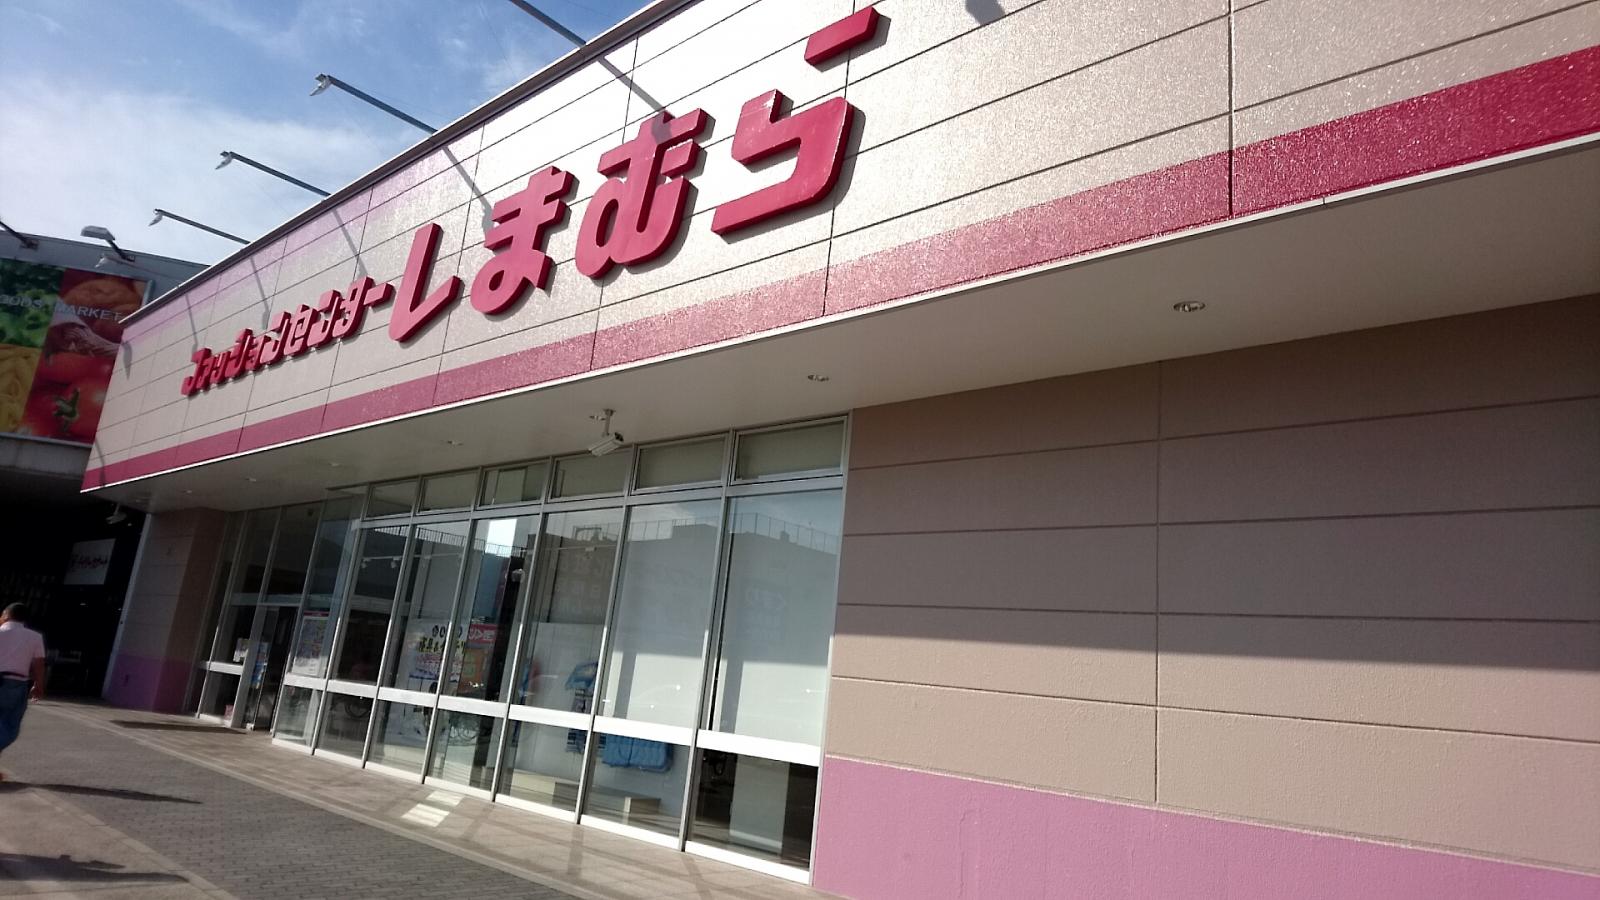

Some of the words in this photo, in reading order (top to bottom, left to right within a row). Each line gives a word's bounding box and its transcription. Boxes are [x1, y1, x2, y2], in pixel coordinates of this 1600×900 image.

[181, 276, 394, 396] ファッションセンター
[388, 6, 881, 343] しまむら
